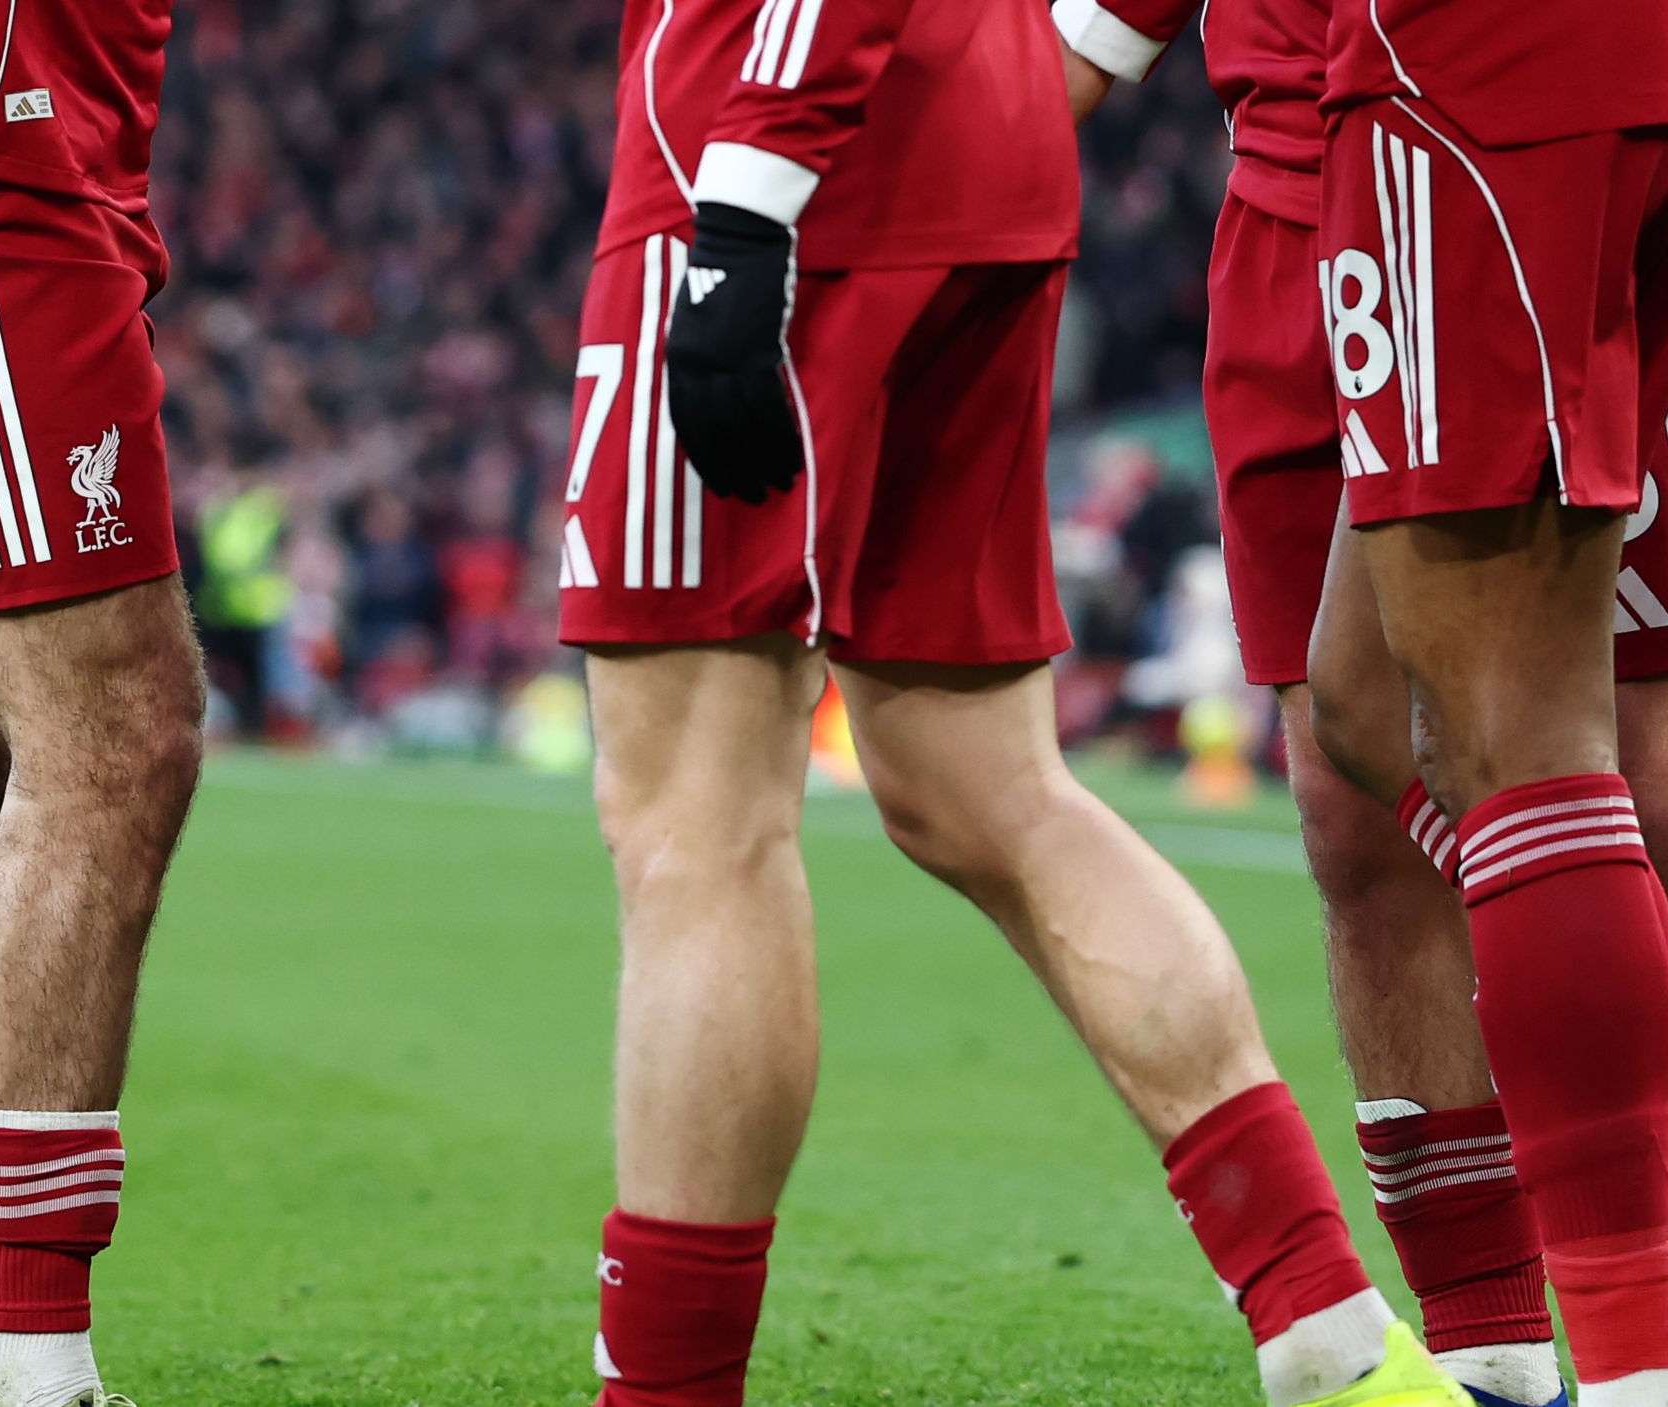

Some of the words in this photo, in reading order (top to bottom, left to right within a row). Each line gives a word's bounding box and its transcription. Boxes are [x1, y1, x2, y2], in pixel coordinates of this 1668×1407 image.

[1317, 247, 1395, 400] 18
[565, 343, 624, 503] 7
[75, 521, 134, 554] L.F.C.
